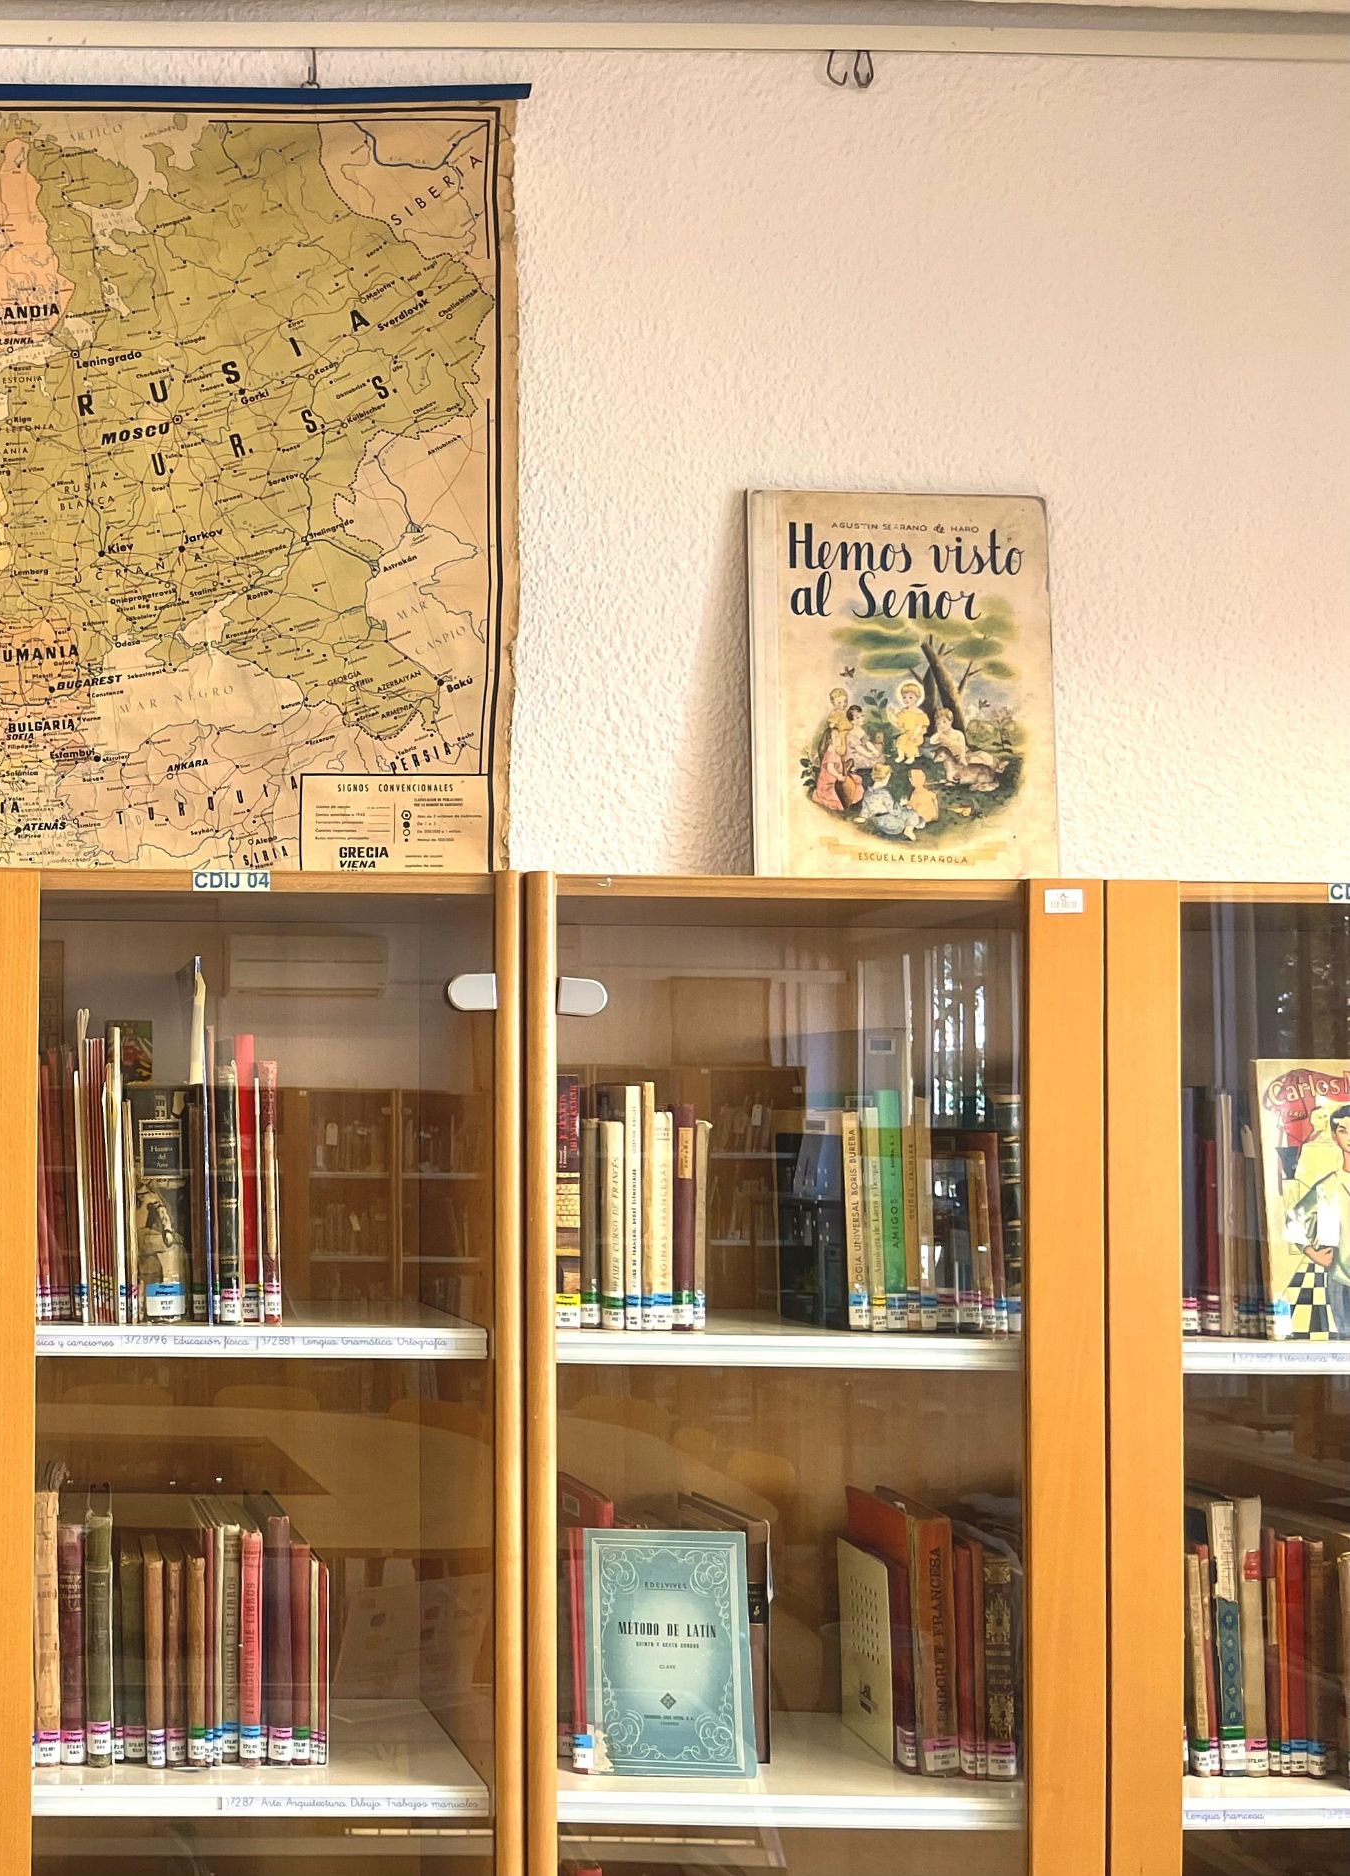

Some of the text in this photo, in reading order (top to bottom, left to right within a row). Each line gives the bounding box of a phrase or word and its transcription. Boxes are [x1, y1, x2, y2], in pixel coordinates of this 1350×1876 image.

[390, 153, 484, 227] SIBERIA
[76, 350, 143, 369] Leningrado
[77, 310, 371, 417] RUSIA
[240, 388, 270, 405] Gorki
[184, 527, 224, 545] Jarkov
[950, 525, 980, 534] HARO
[107, 543, 134, 555] Kiev
[787, 521, 1026, 576] Hemos visto
[790, 570, 982, 621] al Señor
[56, 674, 123, 690] BUCAREST
[7, 719, 75, 733] BULGARIA
[166, 758, 209, 773] ANKARA
[337, 783, 454, 793] SIGNOS CONVENCIONALES
[22, 821, 67, 832] ATENAS
[338, 846, 389, 859] GRECIA
[858, 851, 969, 864] ESCUELA ESPAÑOLA
[339, 860, 377, 869] VIENA
[194, 873, 270, 888] CDIJ 04
[1267, 1077, 1341, 1107] Carlos
[849, 1128, 857, 1164] BUREBA
[850, 1168, 859, 1196] BORIS
[890, 1197, 900, 1249] AMIGOS
[617, 1619, 717, 1638] MÉTODO DE LATÍN
